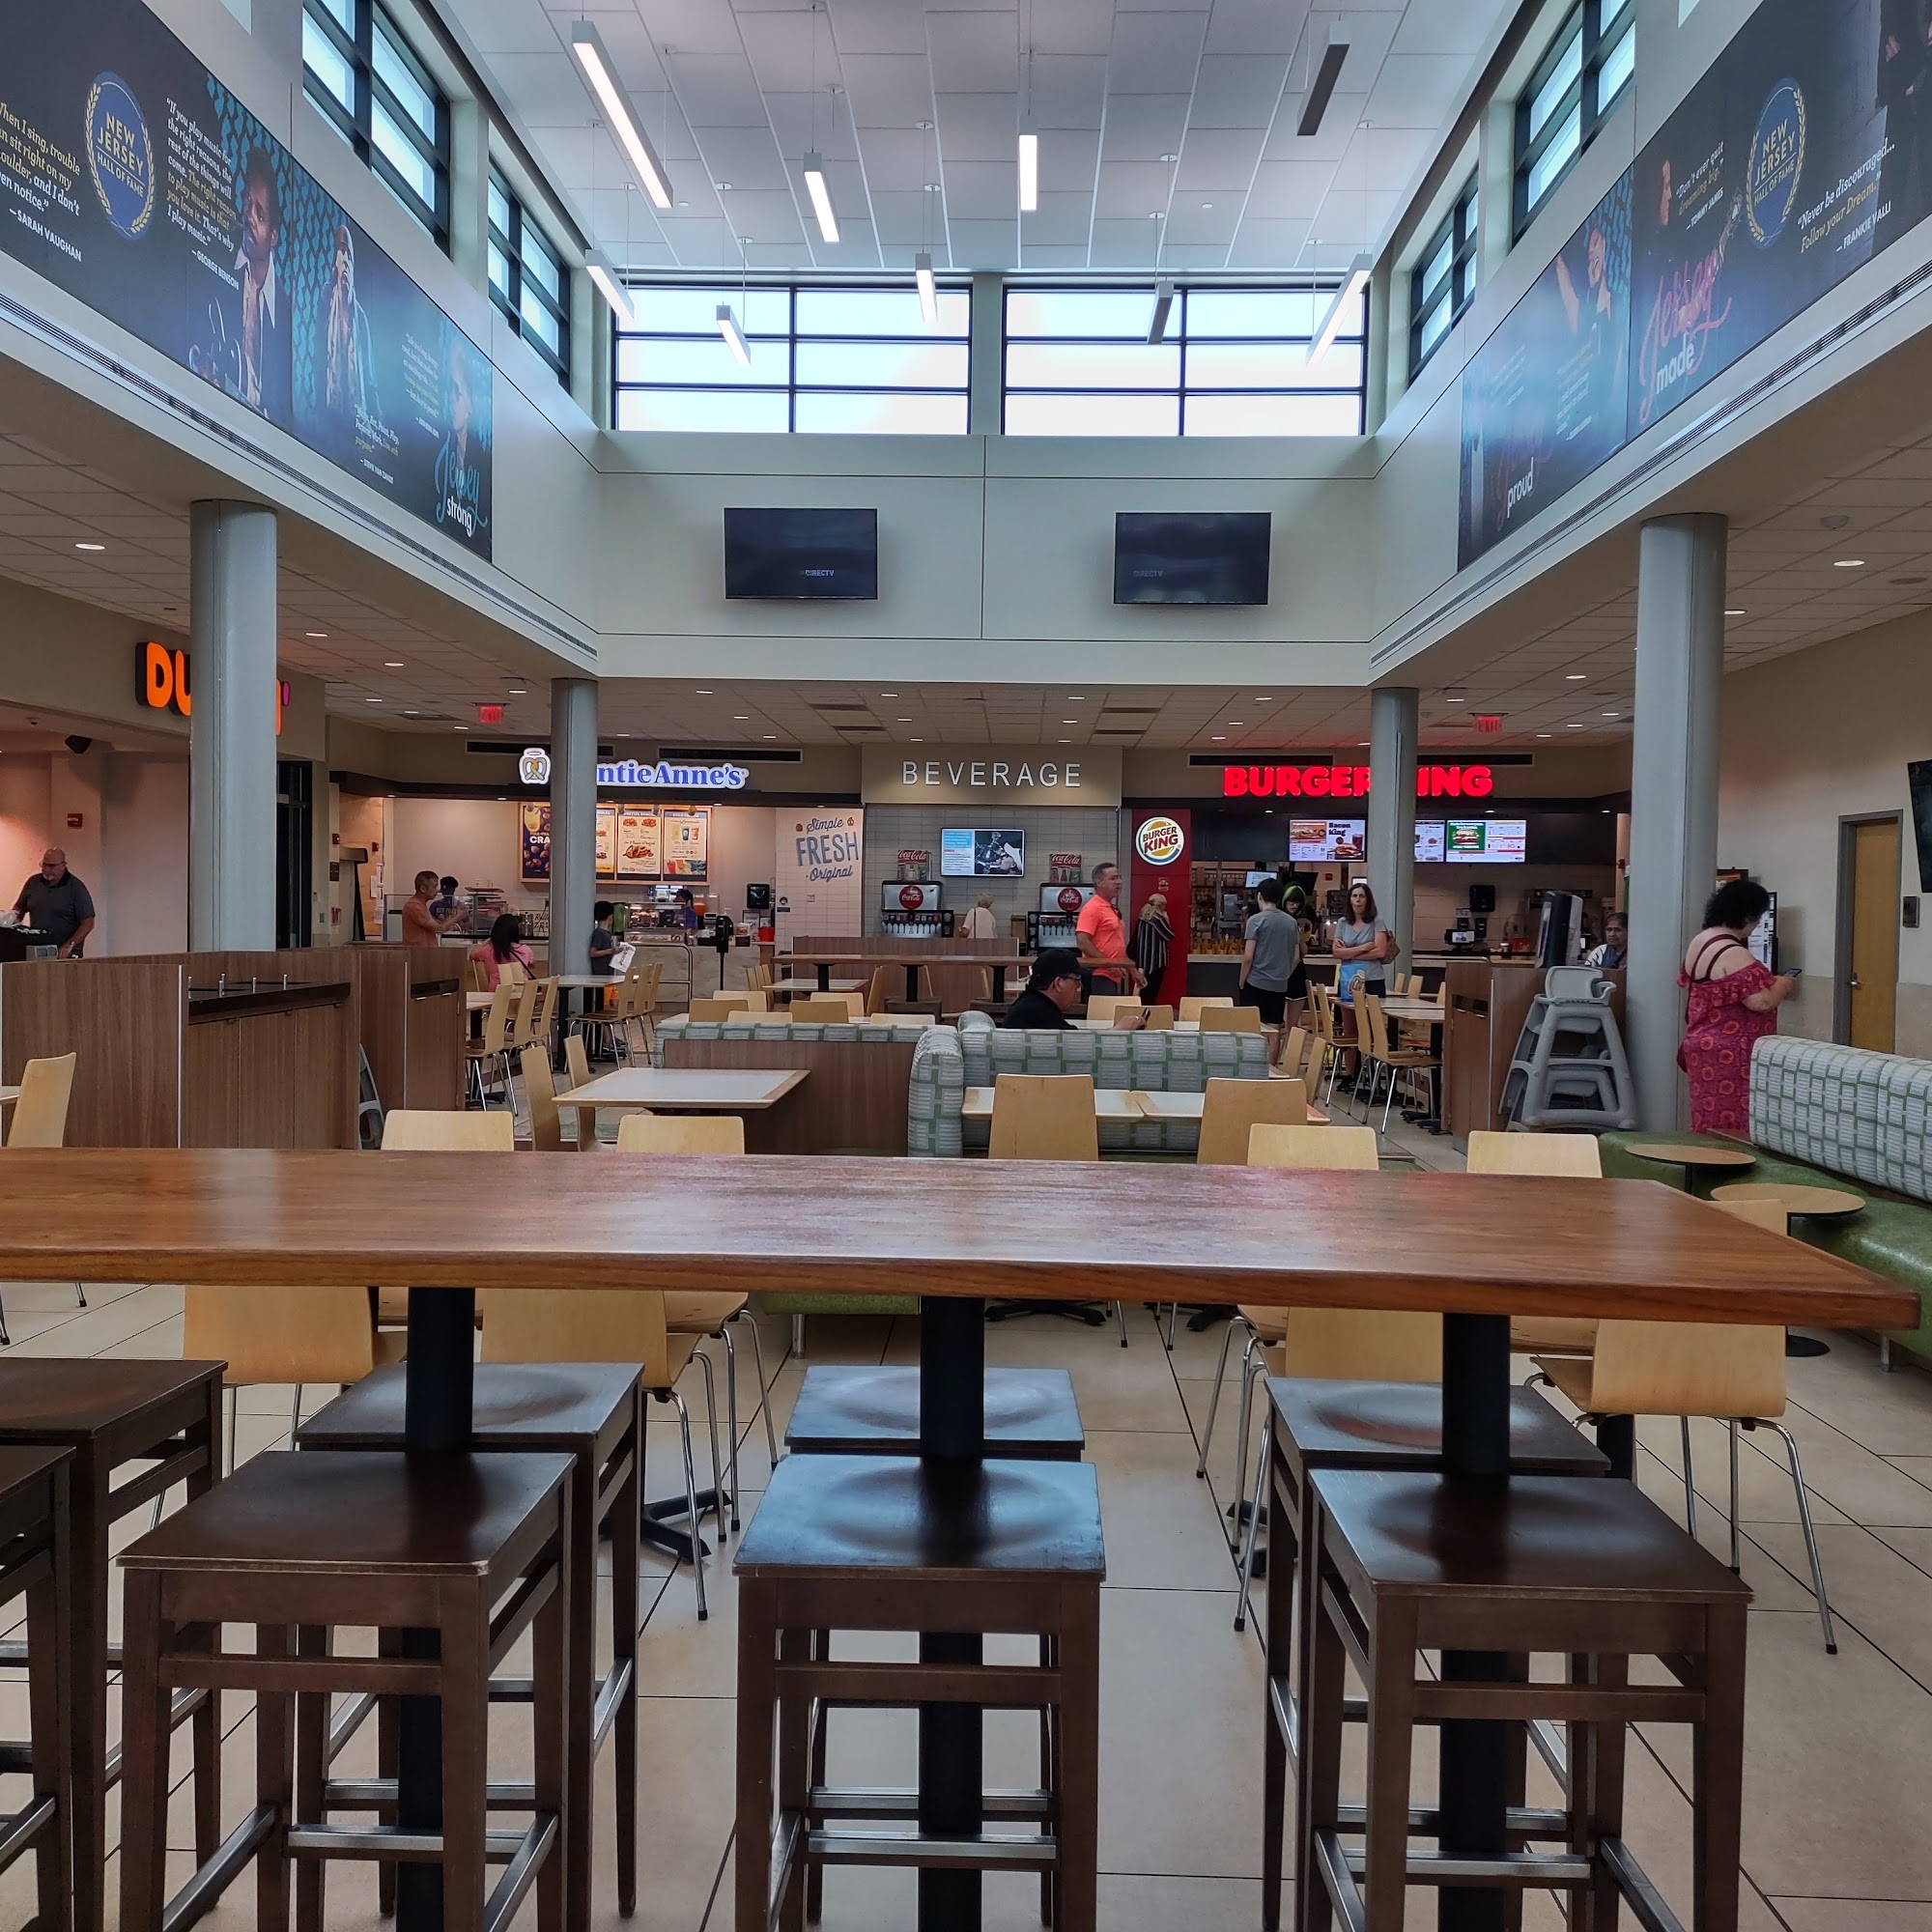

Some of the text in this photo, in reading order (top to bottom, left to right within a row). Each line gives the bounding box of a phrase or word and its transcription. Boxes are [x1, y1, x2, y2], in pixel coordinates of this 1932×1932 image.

[21, 119, 26, 134] I
[27, 128, 48, 154] sing,
[50, 143, 80, 176] trouble
[106, 111, 135, 149] NEW
[176, 109, 188, 128] you
[188, 121, 203, 142] play
[203, 135, 222, 158] music
[222, 149, 232, 166] for
[1762, 118, 1788, 158] NEW
[10, 136, 21, 153] sit
[23, 146, 45, 170] right
[46, 164, 57, 181] on
[59, 173, 71, 191] my
[98, 126, 144, 176] JERSEY
[168, 117, 179, 135] the
[180, 129, 195, 151] right
[222, 166, 232, 184] the
[168, 137, 232, 200] rest of the things will
[1695, 157, 1710, 180] ever
[1710, 140, 1723, 166] quit
[1755, 130, 1795, 186] JERSEY
[98, 152, 144, 198] HALL OF FAME
[188, 169, 200, 188] The
[201, 184, 216, 203] right
[216, 197, 237, 220] reason
[1754, 158, 1795, 207] HALL OF FAME
[34, 175, 51, 195] and
[52, 185, 57, 200] I
[58, 189, 80, 216] don’t
[168, 171, 230, 231] to play music is that
[1708, 186, 1723, 210] JAMES
[1824, 190, 1835, 209] be
[1871, 200, 1891, 225] VALLI
[166, 189, 180, 206] you
[180, 196, 193, 217] love
[222, 235, 235, 252] why
[168, 204, 172, 216] I
[172, 209, 186, 231] play
[1801, 222, 1826, 253] Follow
[1825, 206, 1846, 236] your
[44, 227, 81, 262] VAUGHAN
[218, 266, 240, 291] BENSON
[1656, 331, 1695, 395] made
[1507, 456, 1534, 519] proud
[446, 496, 472, 538] strong
[597, 762, 652, 783] ntie
[901, 760, 1081, 787] BEVERAGE
[1223, 766, 1493, 797] BURGER ING
[529, 836, 551, 844] CRA
[807, 817, 844, 835] Simple
[1143, 826, 1177, 842] BURGER
[1144, 834, 1179, 854] KING
[796, 831, 859, 867] FRESH
[810, 865, 853, 883] Original
